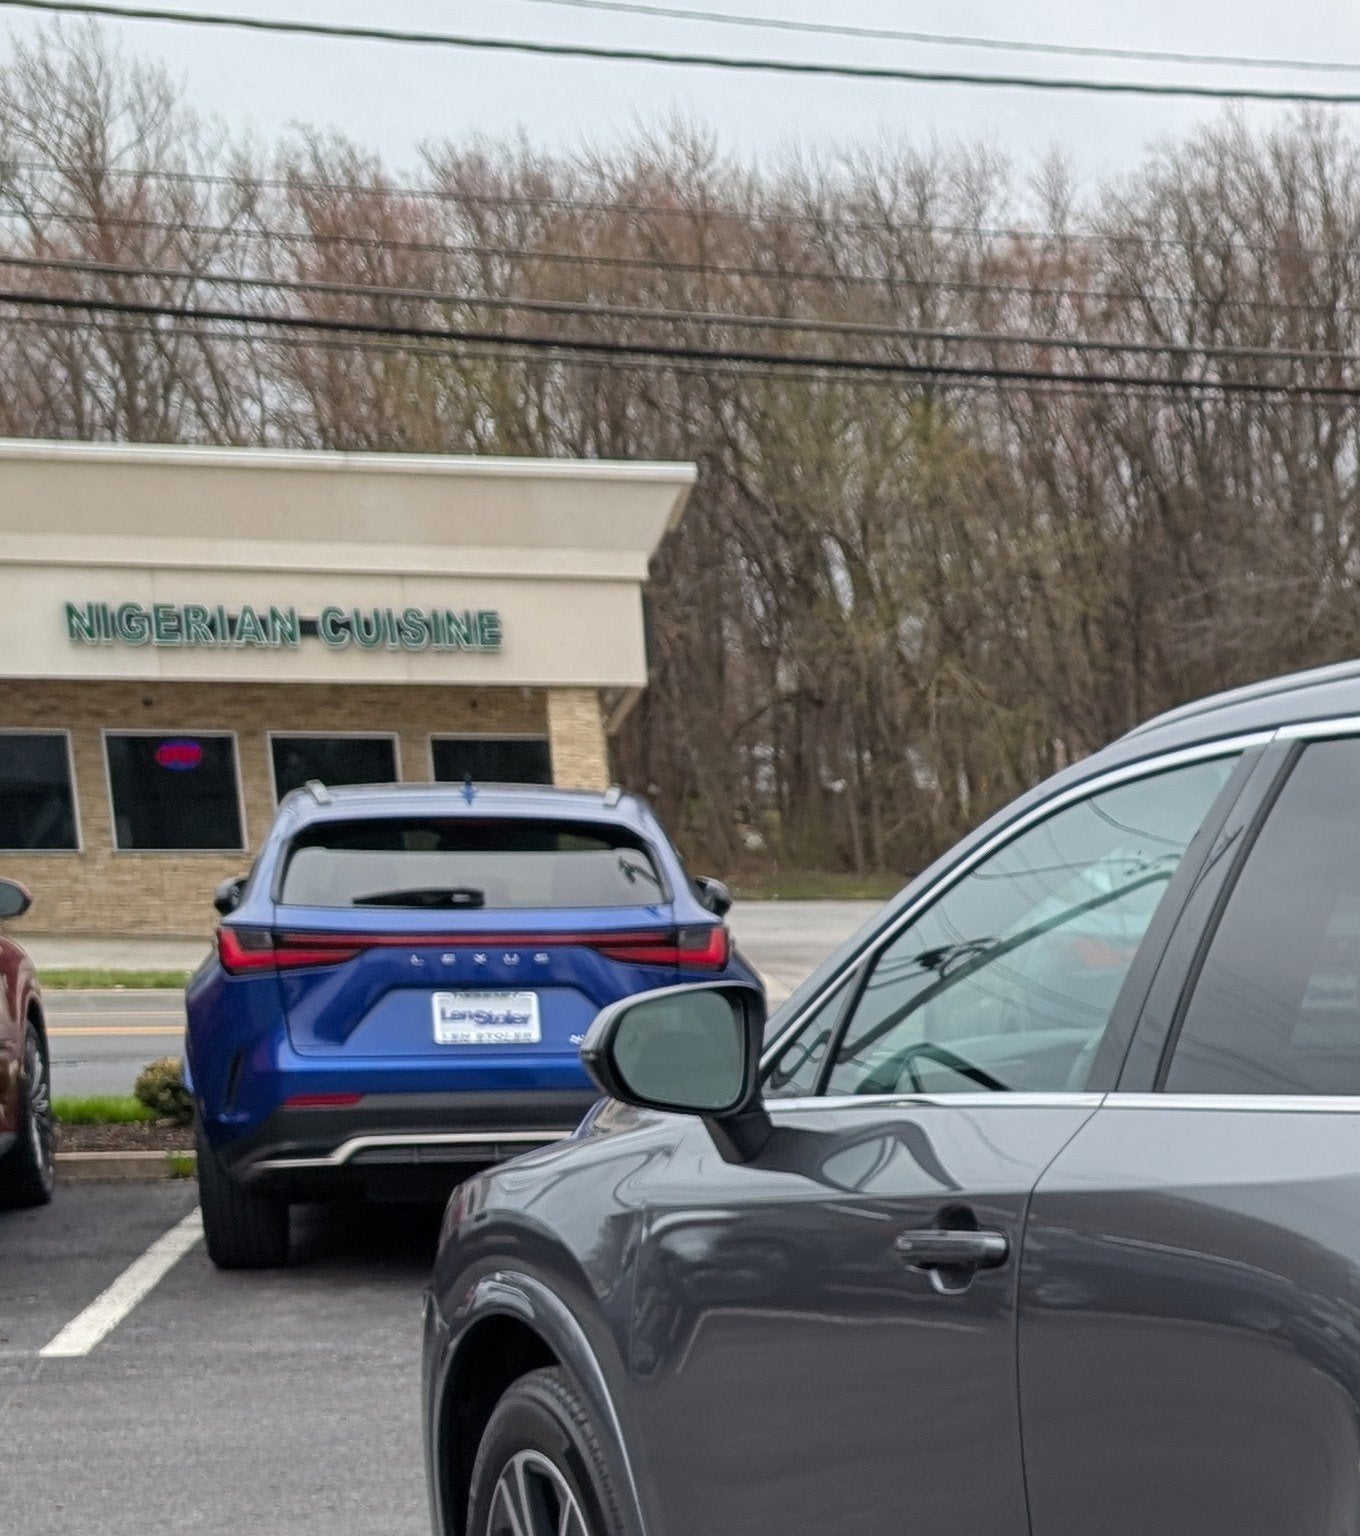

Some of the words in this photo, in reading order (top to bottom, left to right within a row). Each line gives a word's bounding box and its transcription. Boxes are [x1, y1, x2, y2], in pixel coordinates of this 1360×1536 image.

[65, 601, 300, 648] NIGERIAN
[318, 606, 502, 651] CUISINE
[409, 953, 550, 966] LEXUS
